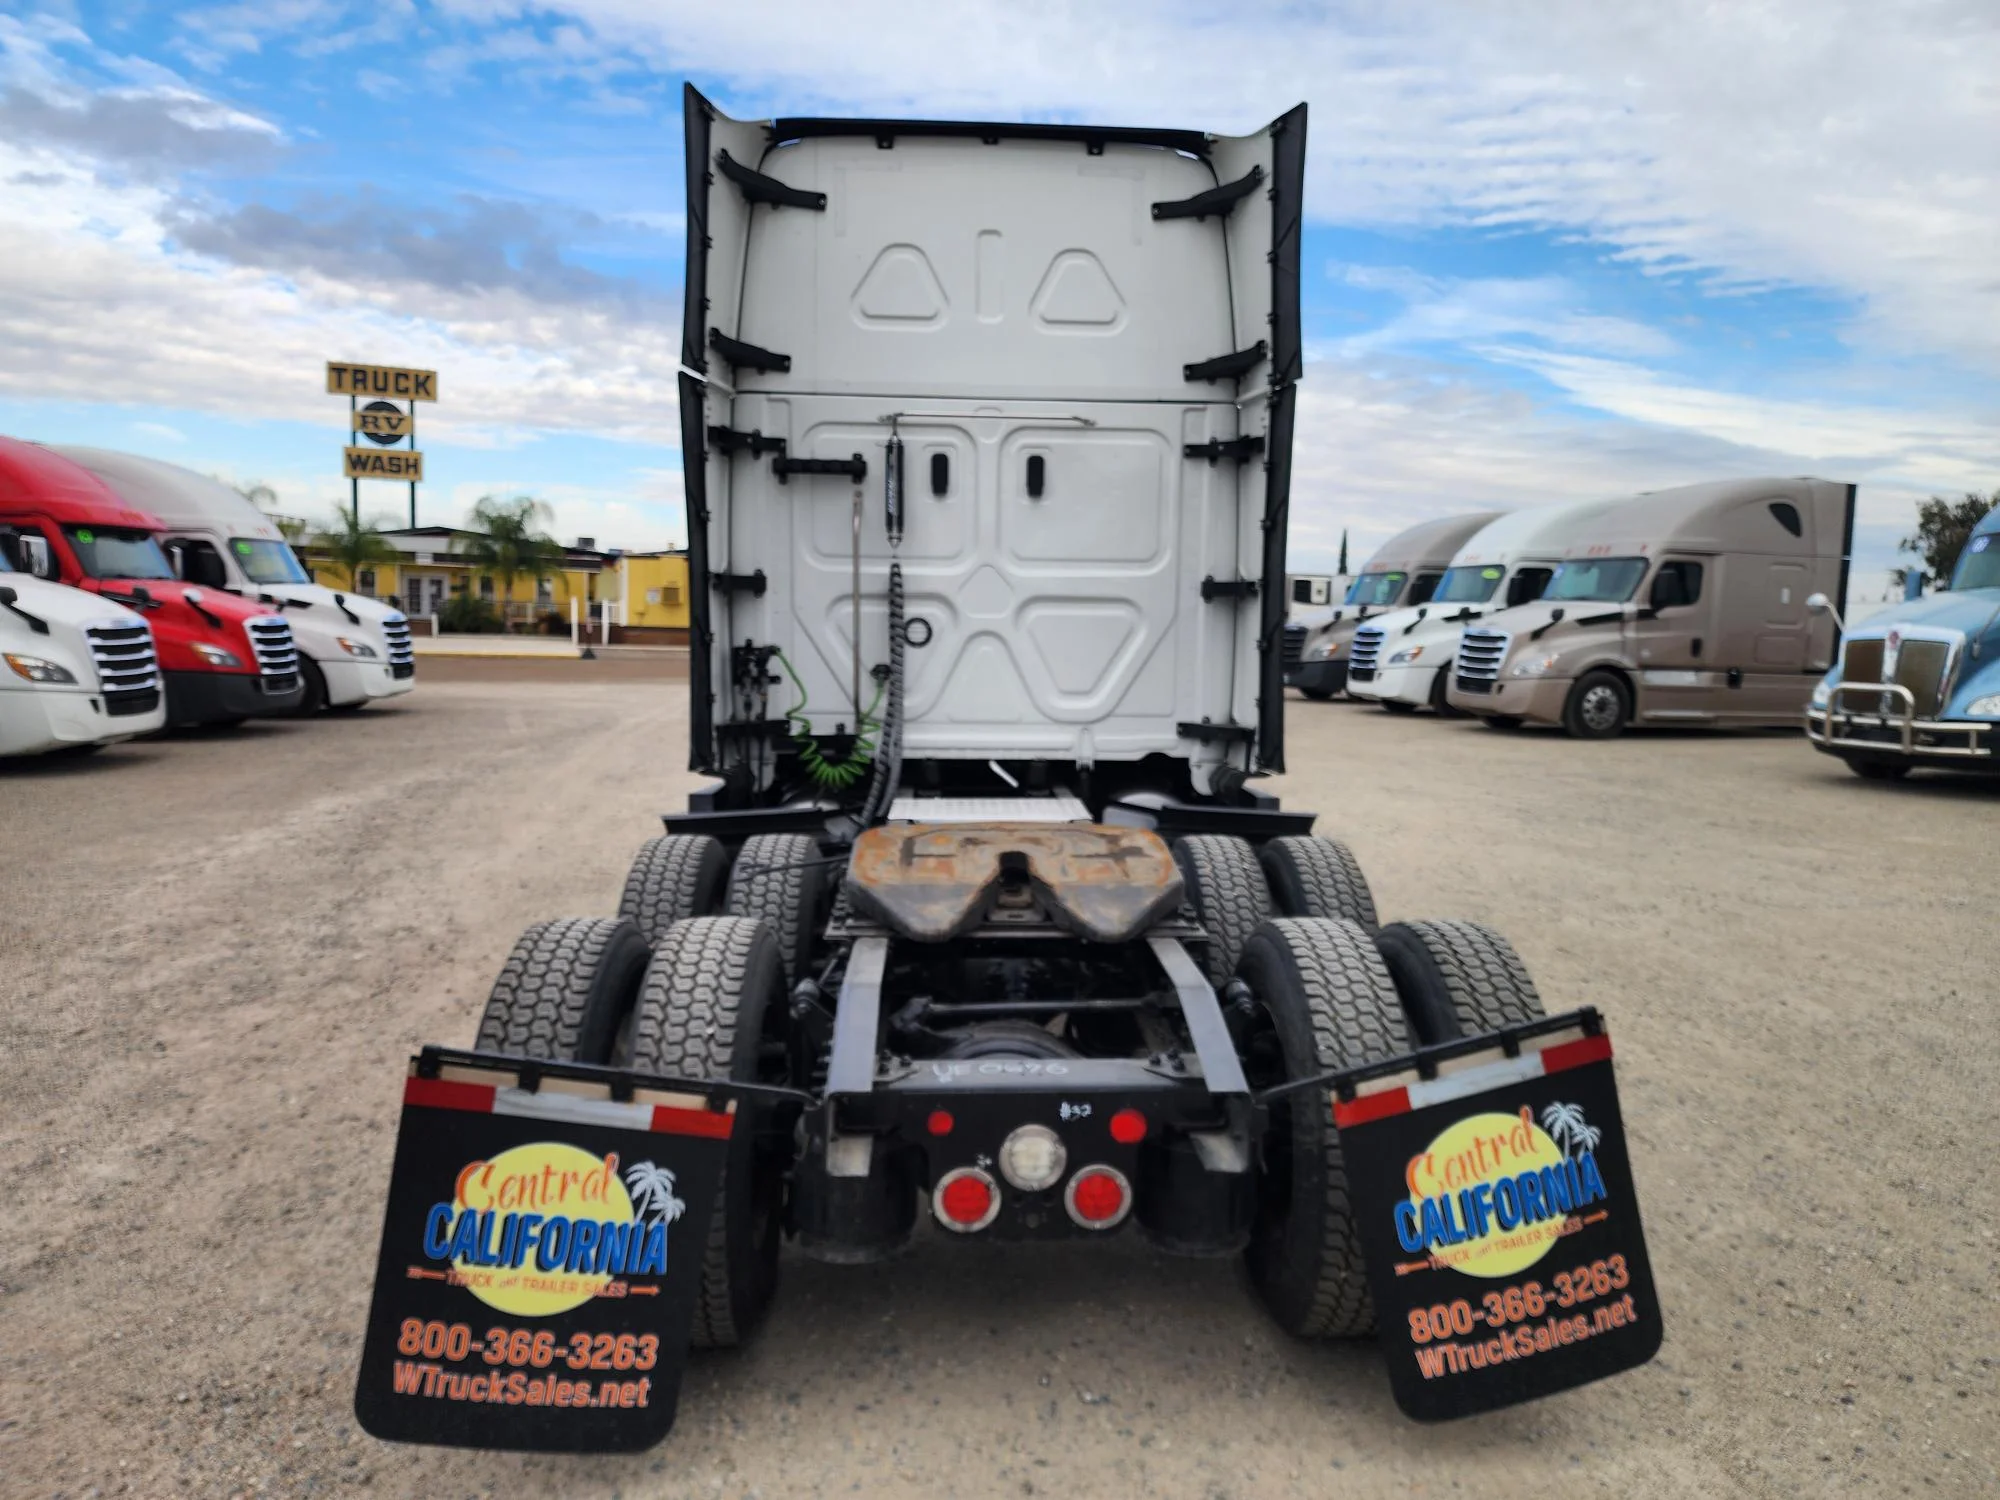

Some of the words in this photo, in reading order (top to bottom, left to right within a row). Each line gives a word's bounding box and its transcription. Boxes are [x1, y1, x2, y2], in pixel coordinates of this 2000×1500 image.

[330, 367, 432, 397] TRUCK
[360, 414, 404, 431] RV
[347, 453, 419, 474] WASH
[1406, 1104, 1539, 1201] Central
[455, 1152, 620, 1216] Central
[1393, 1152, 1608, 1253] CALIFORNIA
[423, 1202, 668, 1276] CALIFORNIA
[447, 1268, 494, 1288] TRUCK
[522, 1276, 578, 1295] TRAILER
[581, 1280, 629, 1298] SALES
[1408, 1253, 1630, 1345] 800-366-3263
[398, 1317, 659, 1371] 800-366-3263
[1414, 1293, 1638, 1380] WTruckSales.net
[393, 1360, 652, 1409] WTruckSales.net
